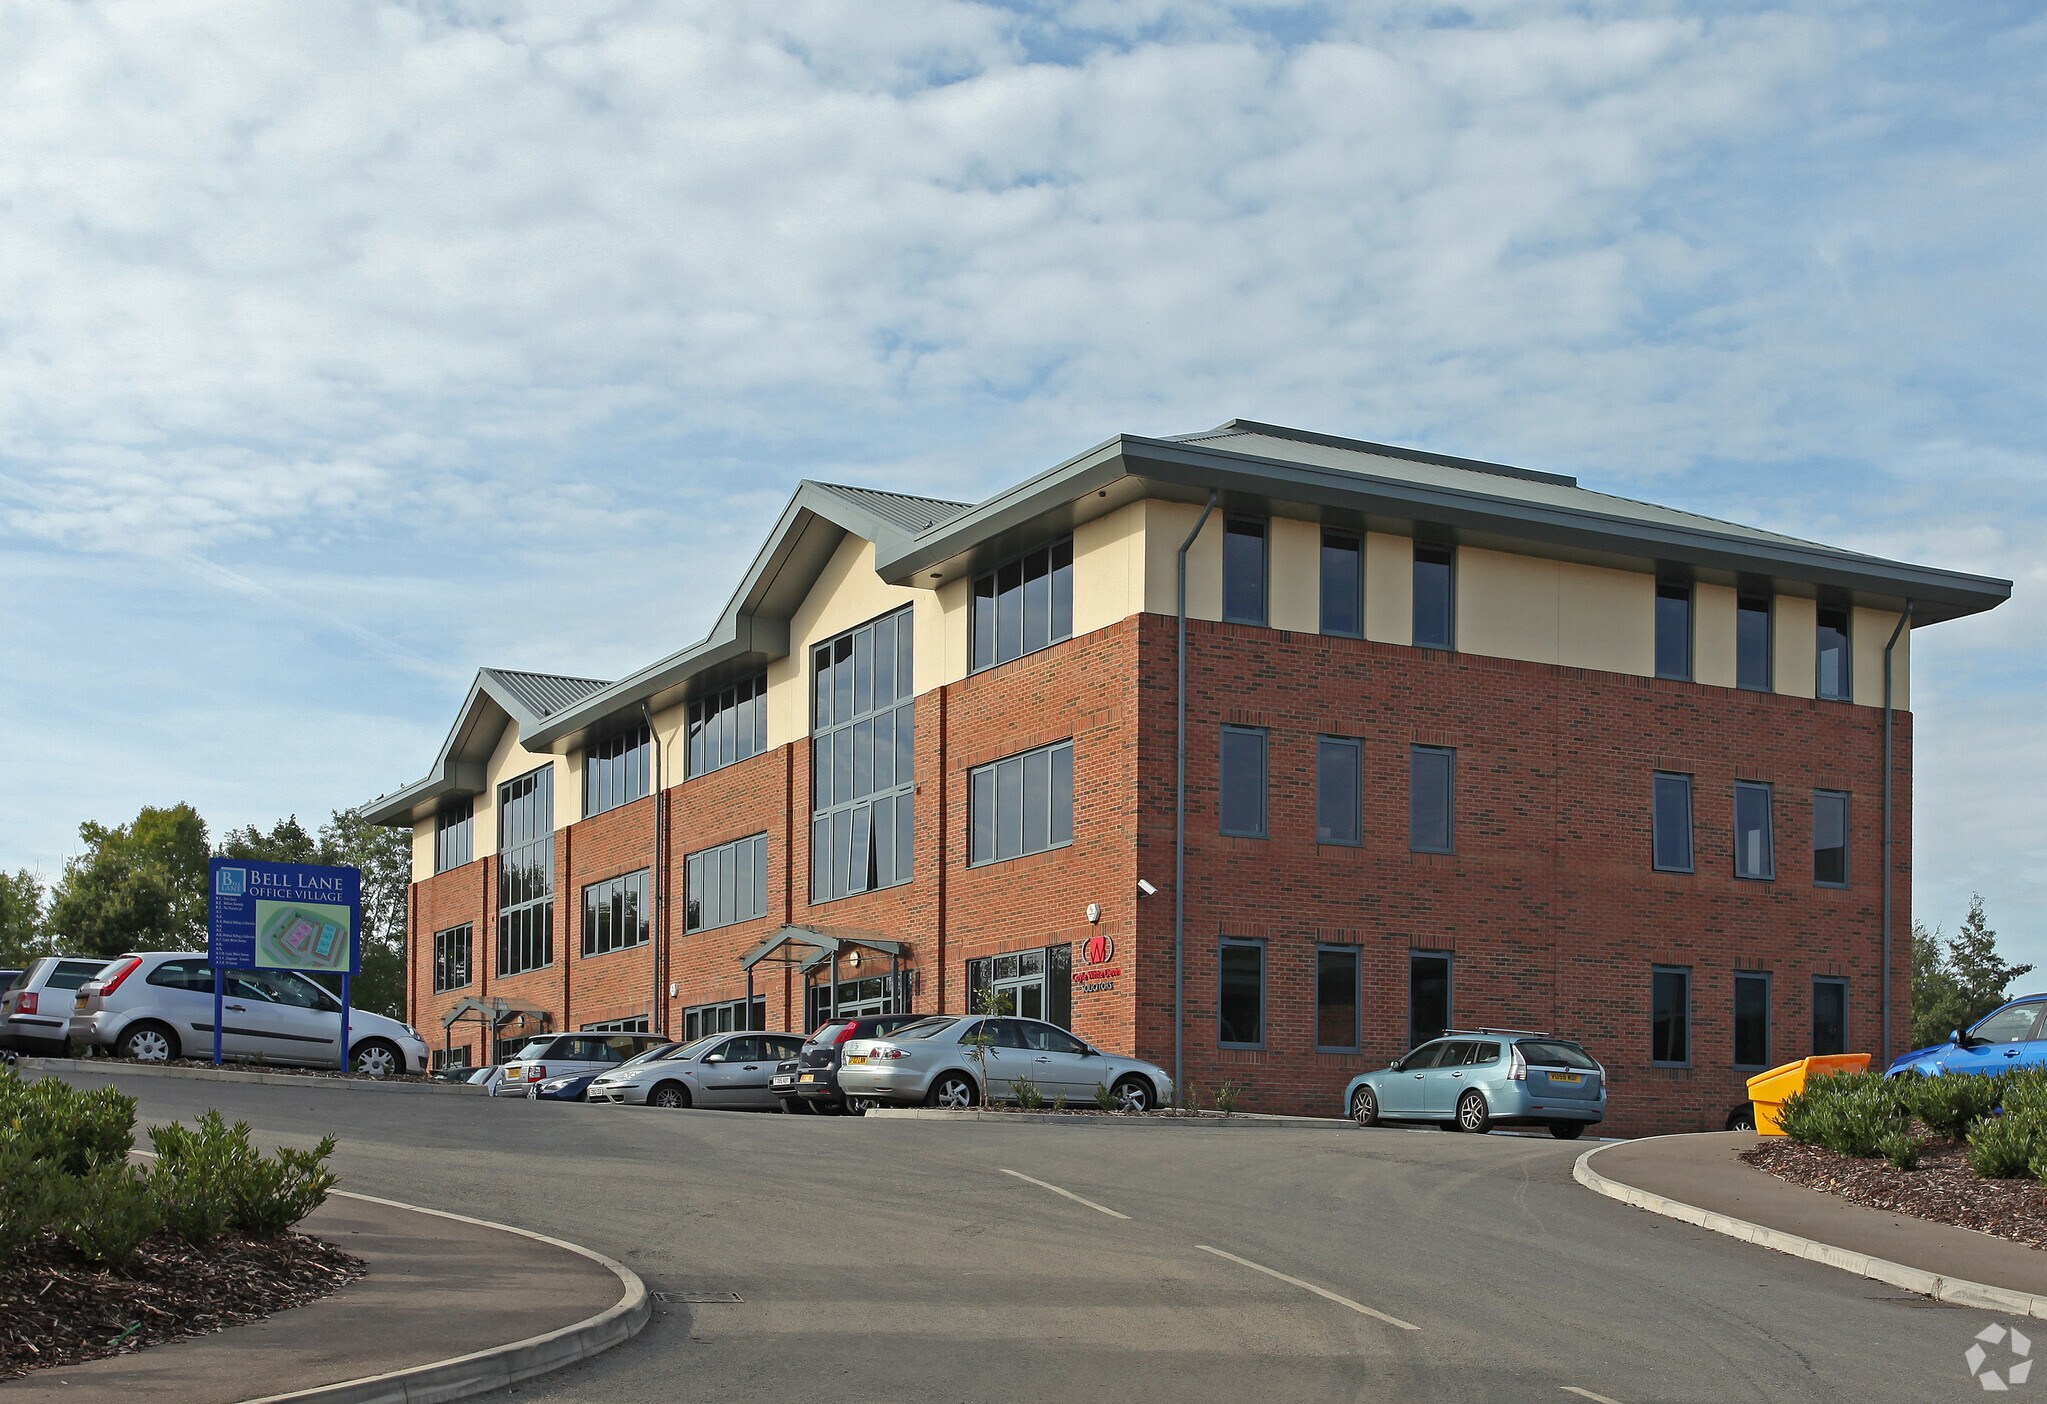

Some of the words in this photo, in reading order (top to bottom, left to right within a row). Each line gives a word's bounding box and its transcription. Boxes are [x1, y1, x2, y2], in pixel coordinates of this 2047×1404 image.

[250, 870, 291, 887] BELL
[298, 873, 343, 891] LANE
[249, 887, 292, 898] OFFICE
[295, 890, 343, 902] VILLAGE
[1081, 981, 1114, 993] SOLICITORS
